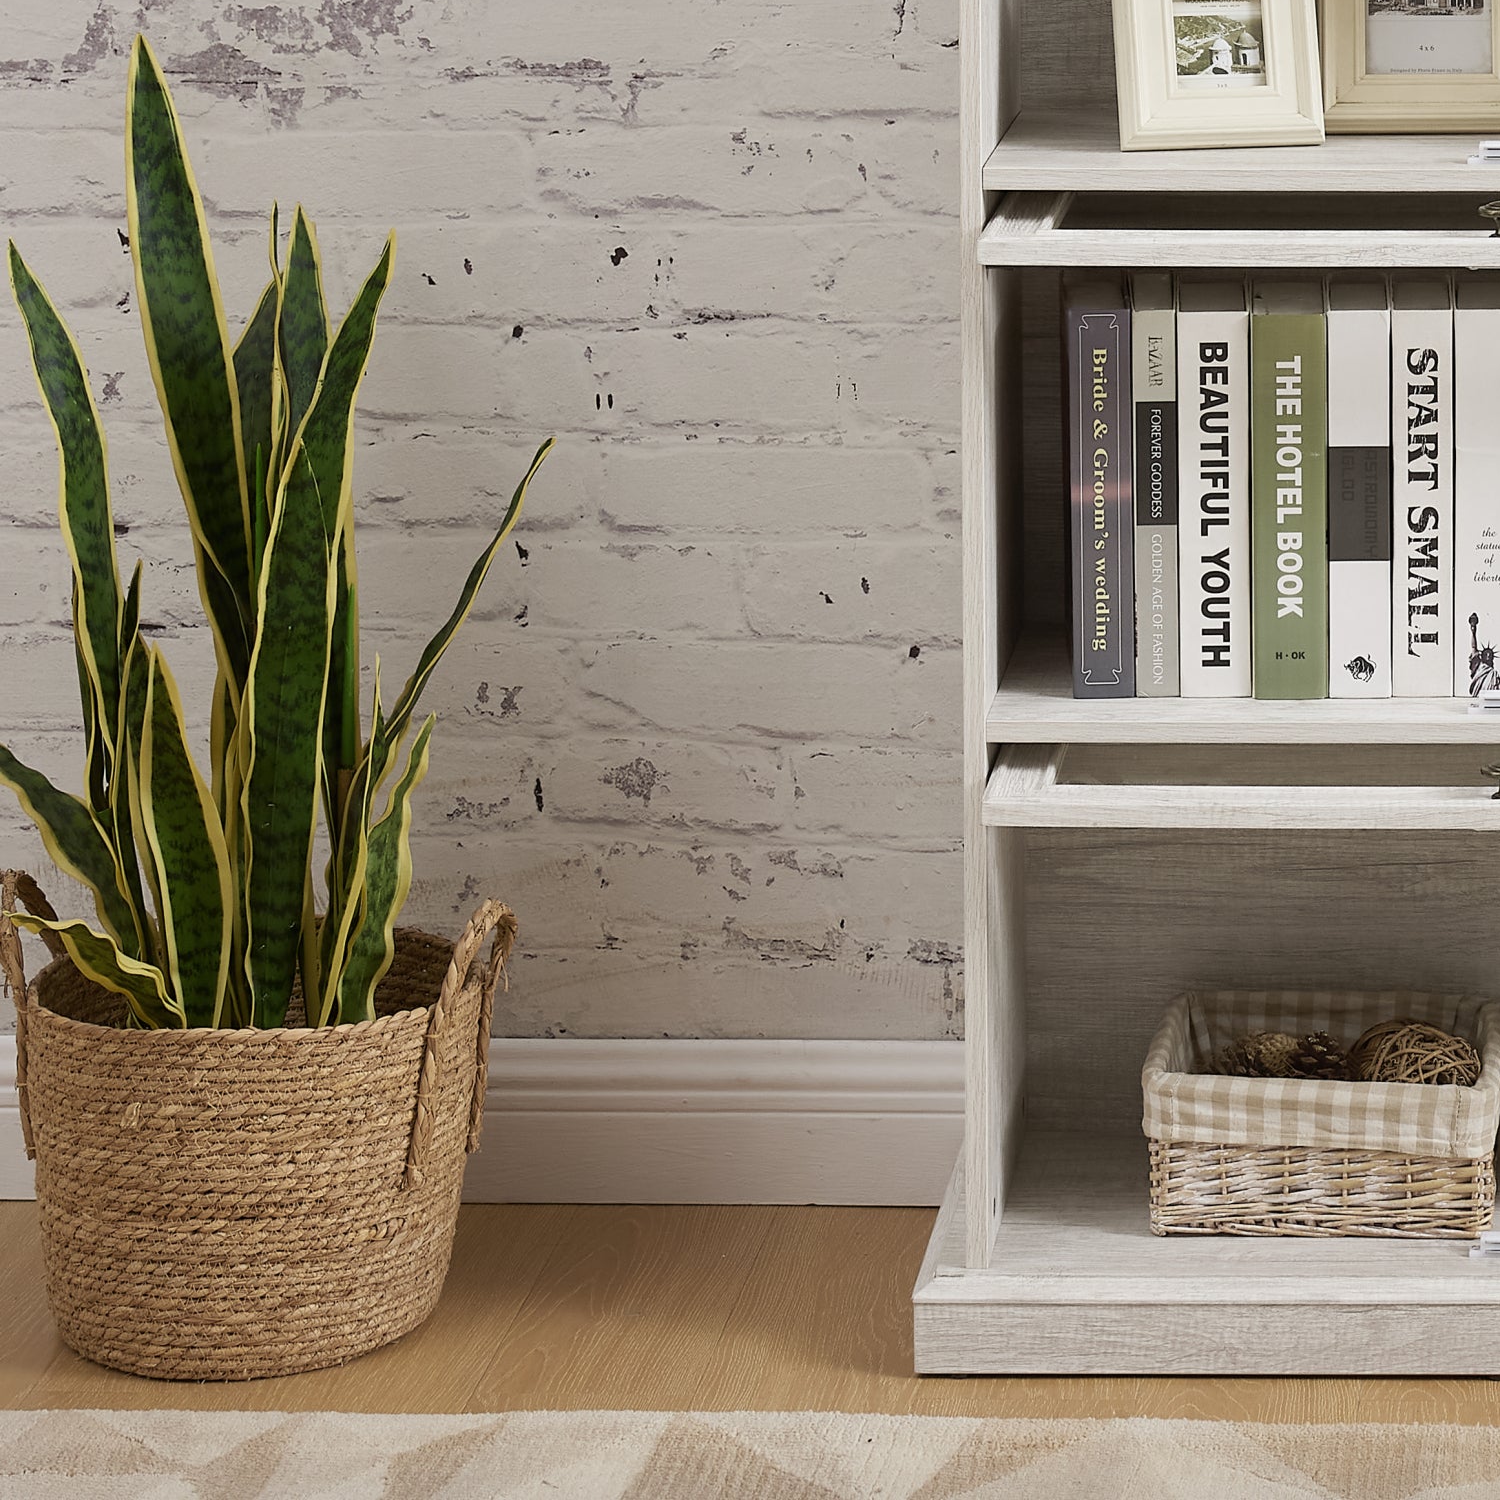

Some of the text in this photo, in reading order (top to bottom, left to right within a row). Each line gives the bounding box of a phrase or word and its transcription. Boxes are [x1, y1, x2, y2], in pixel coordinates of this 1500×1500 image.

[1148, 336, 1164, 387] BAZAAR
[1092, 348, 1110, 651] Bride & Groom's wedding
[1151, 409, 1162, 518] FOREVER GODDESS
[1199, 341, 1231, 668] BEAUTIFUL YOUTH
[1275, 355, 1303, 619] THE HOTEL BOOK
[1407, 347, 1439, 658] START SMALL
[1482, 527, 1497, 538] the
[1484, 554, 1496, 567] of
[1152, 534, 1163, 684] GOLDEN AGE OF FASHION
[1275, 652, 1305, 660] H OK
